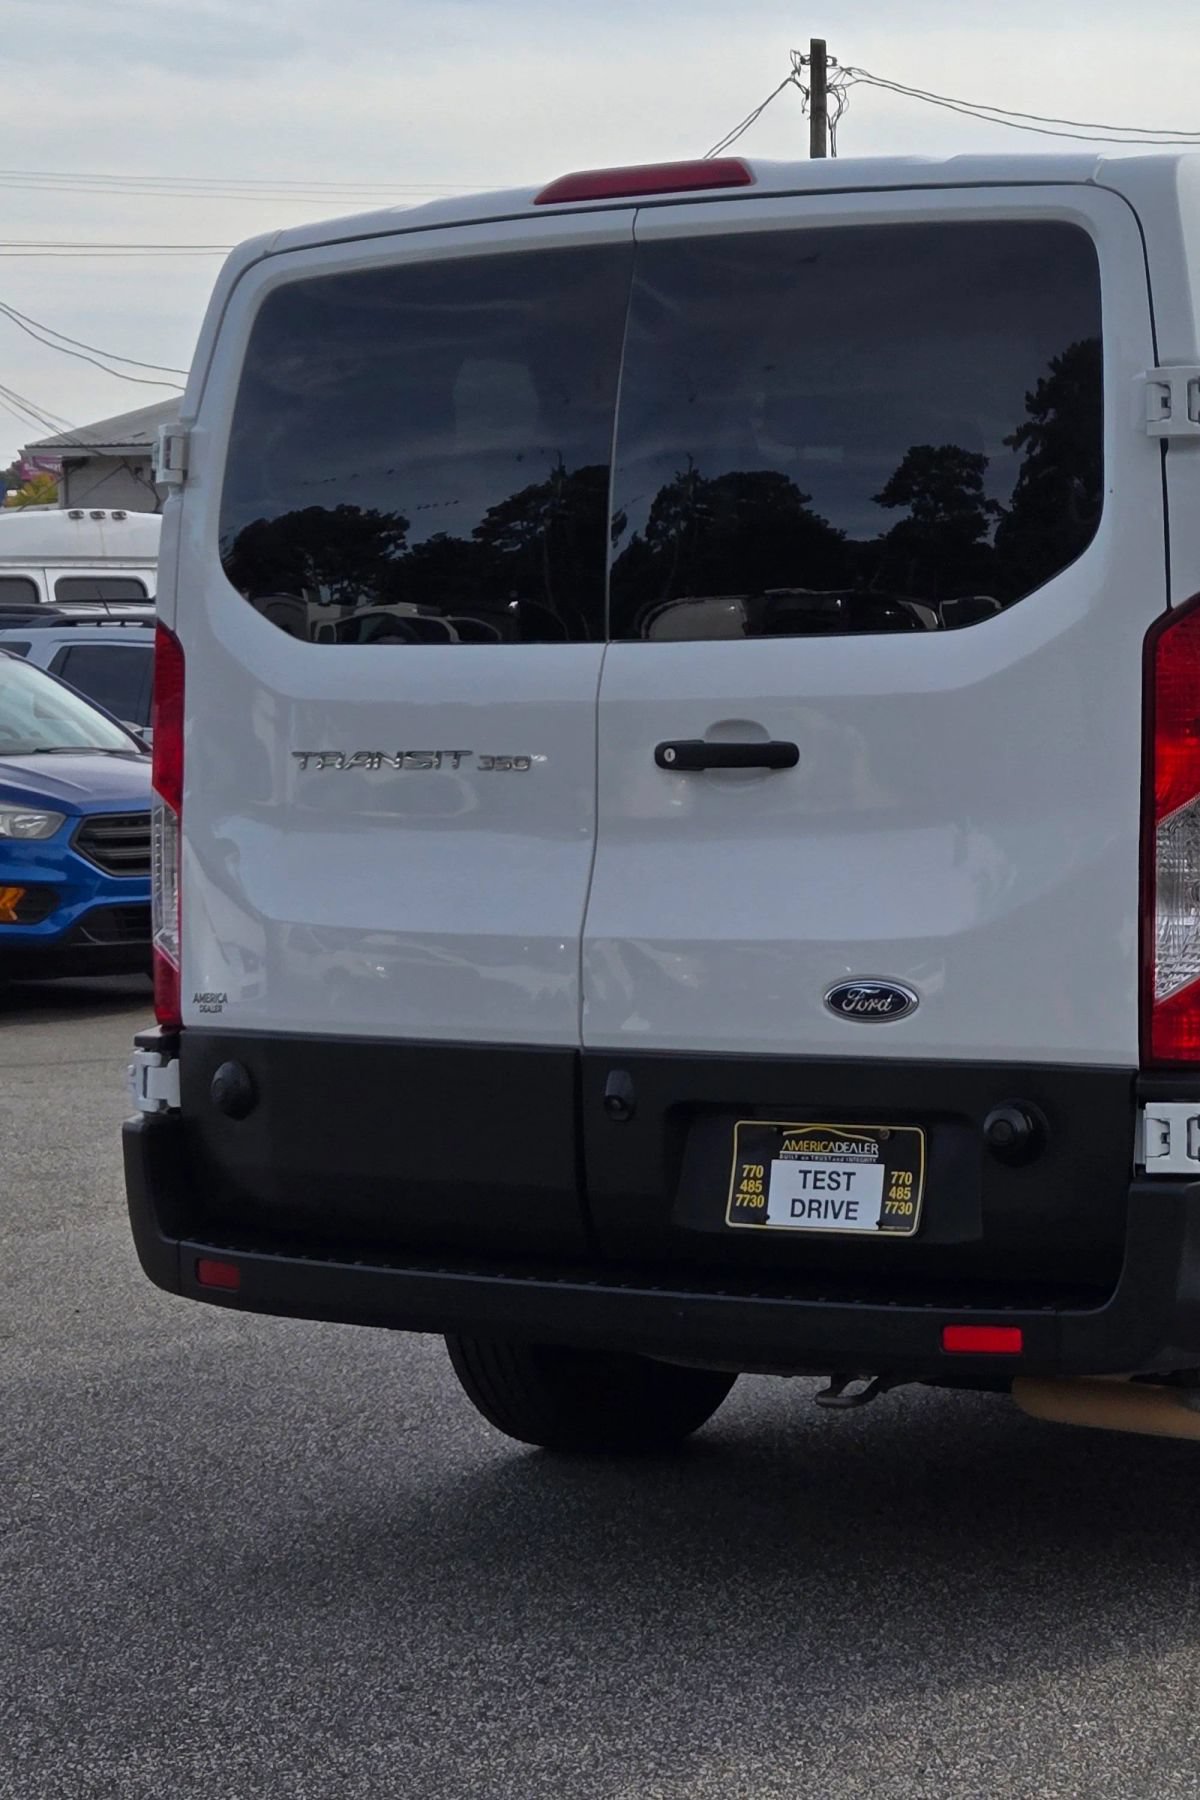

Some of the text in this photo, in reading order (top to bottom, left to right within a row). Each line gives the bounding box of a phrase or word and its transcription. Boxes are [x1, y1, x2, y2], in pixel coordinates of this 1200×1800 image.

[292, 750, 532, 771] TRANSIT 350
[192, 992, 228, 1003] AMERICA
[842, 987, 893, 1011] Ford
[742, 1164, 764, 1178] 770
[890, 1171, 913, 1186] 770
[739, 1179, 763, 1193] 485
[798, 1169, 857, 1192] TEST
[735, 1193, 765, 1208] 7730
[888, 1186, 911, 1200] 485
[790, 1198, 860, 1221] DRIVE
[884, 1200, 913, 1216] 7730
